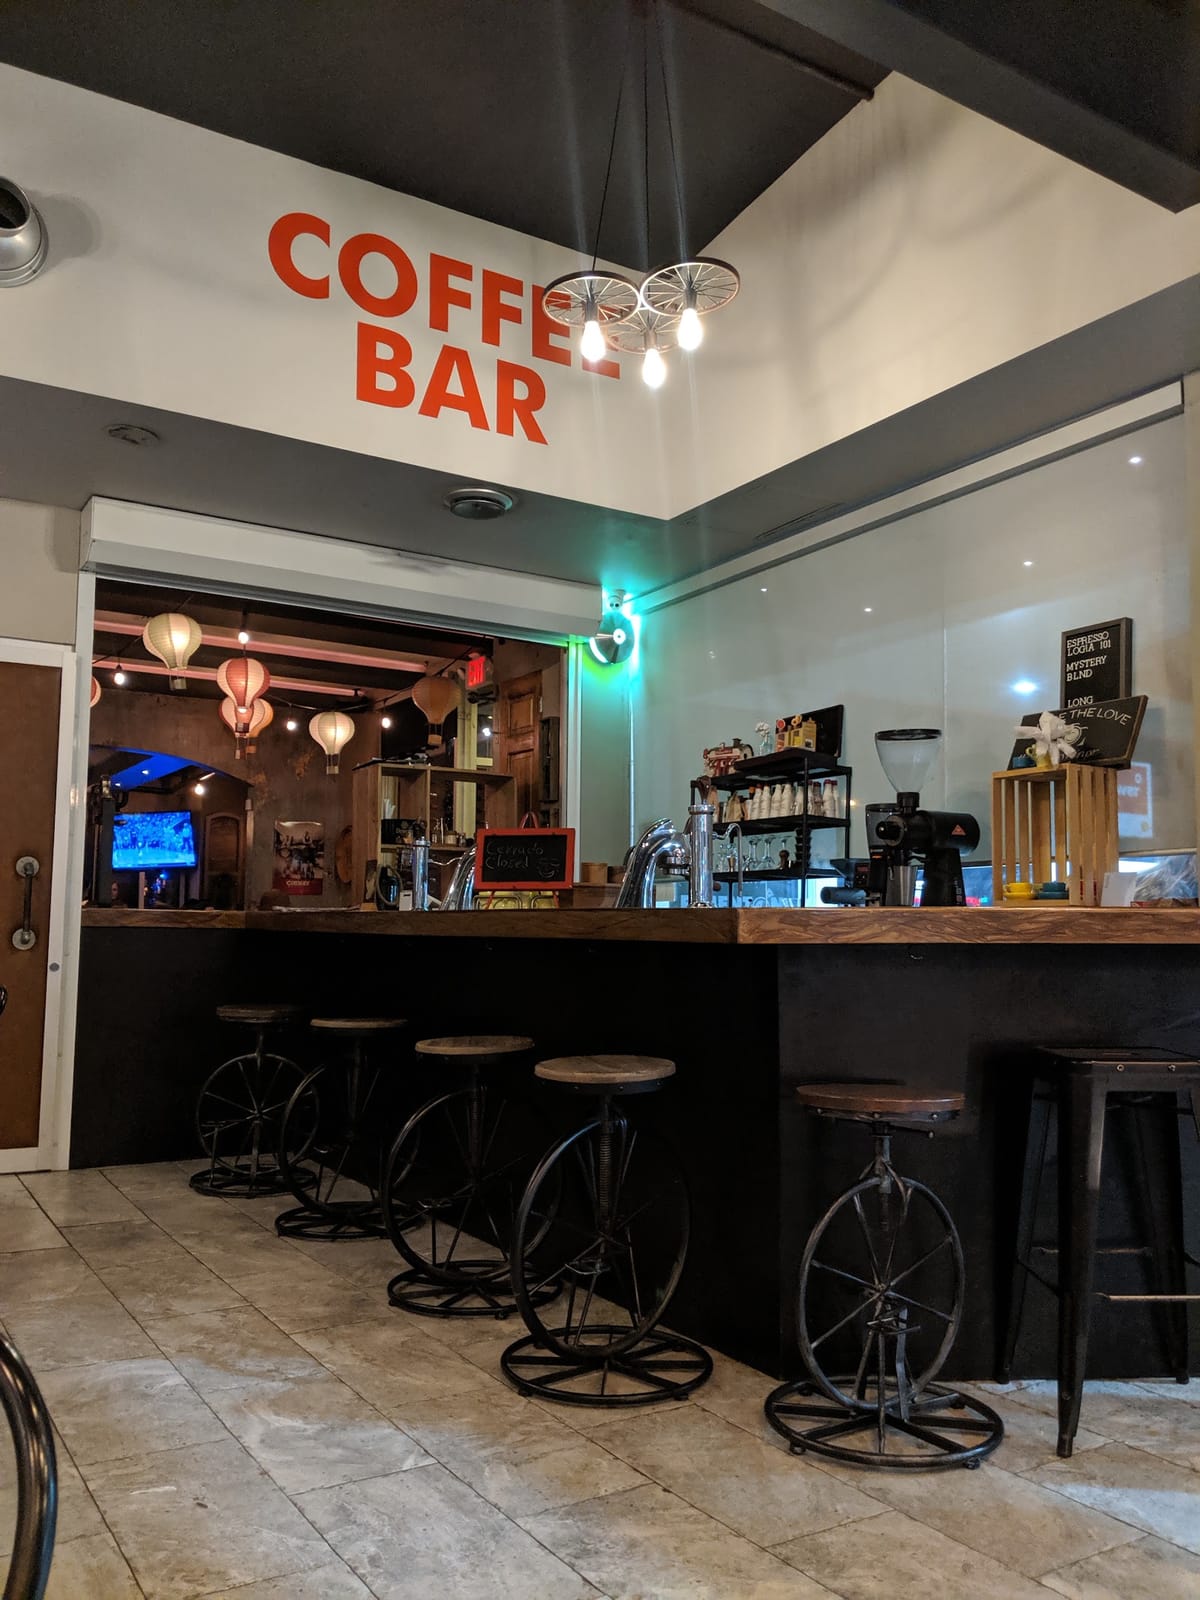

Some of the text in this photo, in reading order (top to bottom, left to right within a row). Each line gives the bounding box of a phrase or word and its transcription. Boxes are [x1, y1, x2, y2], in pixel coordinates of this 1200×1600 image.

[356, 321, 549, 446] BAR
[1066, 631, 1109, 649] ESPRESSO
[1067, 643, 1095, 657] LOGIA
[1066, 655, 1107, 672] MYSTERY
[1067, 696, 1093, 708] LONG
[1070, 707, 1096, 719] THE
[1097, 707, 1132, 725] LOVE
